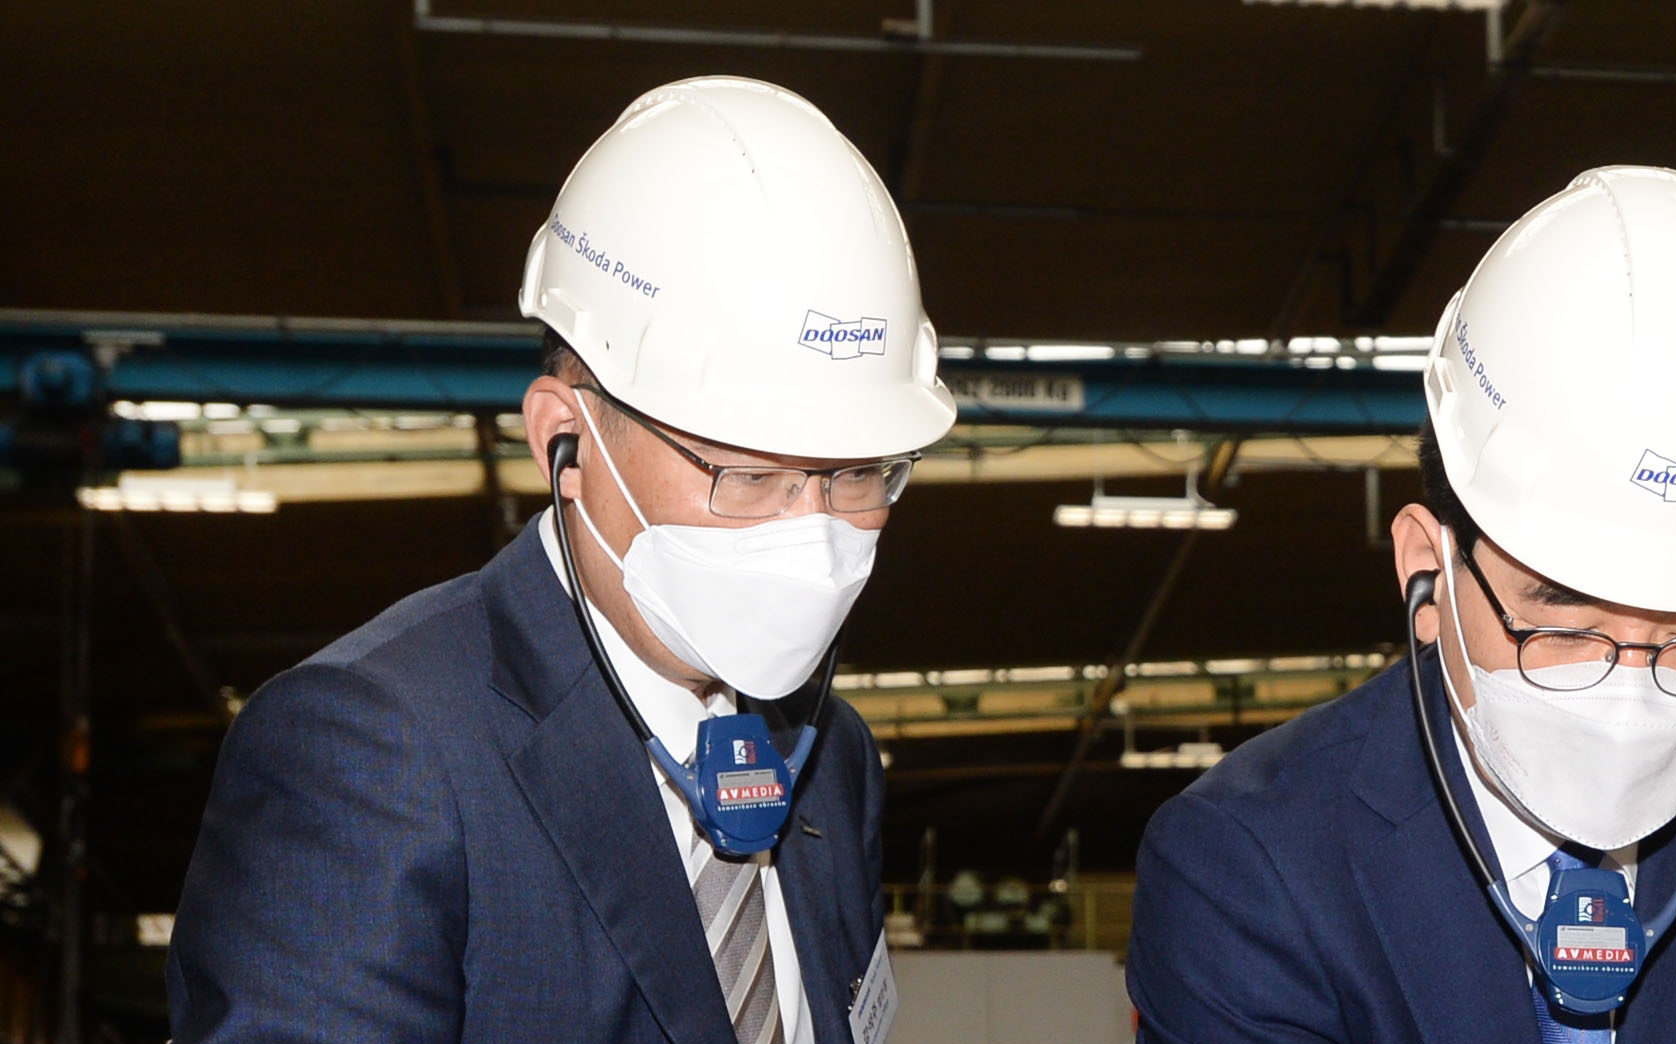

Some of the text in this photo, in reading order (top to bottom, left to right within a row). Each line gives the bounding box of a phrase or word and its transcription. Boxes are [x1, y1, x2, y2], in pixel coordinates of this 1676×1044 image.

[575, 231, 611, 272] Škoda
[612, 260, 661, 299] Power
[803, 327, 885, 342] DOOSAN
[1473, 361, 1507, 411] Power
